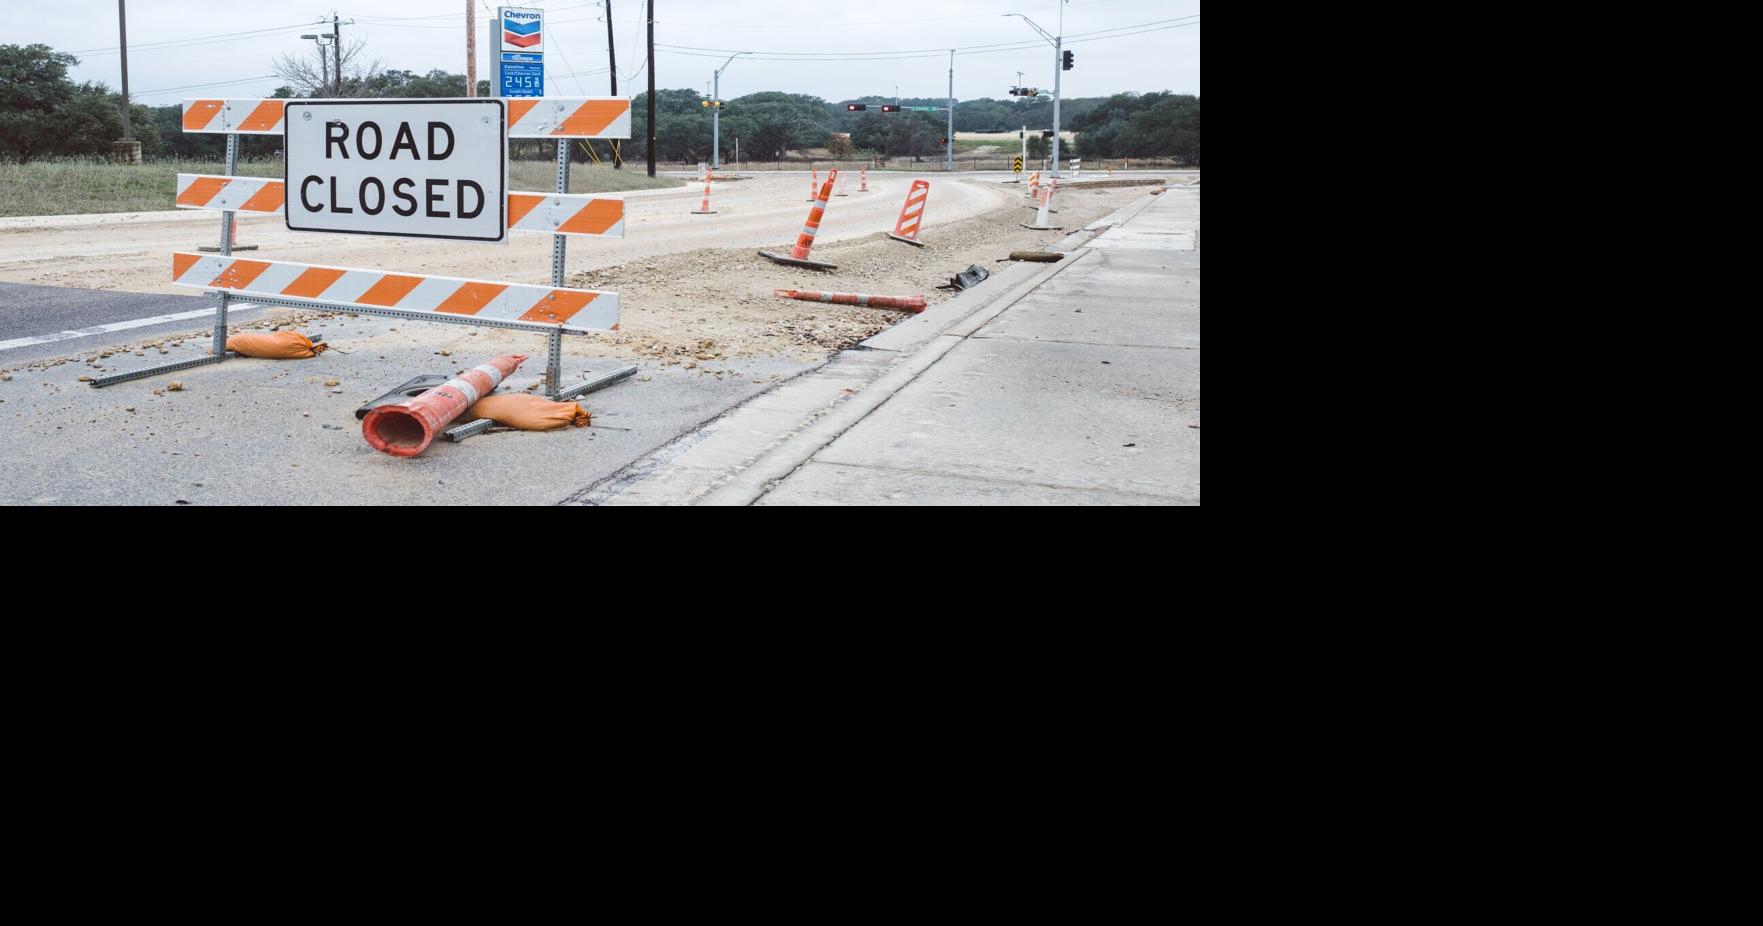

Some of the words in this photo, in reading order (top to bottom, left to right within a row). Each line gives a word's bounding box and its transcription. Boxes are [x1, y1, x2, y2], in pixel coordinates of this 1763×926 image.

[504, 10, 540, 19] Chevron
[325, 120, 455, 161] ROAD
[300, 174, 485, 219] CLOSED
